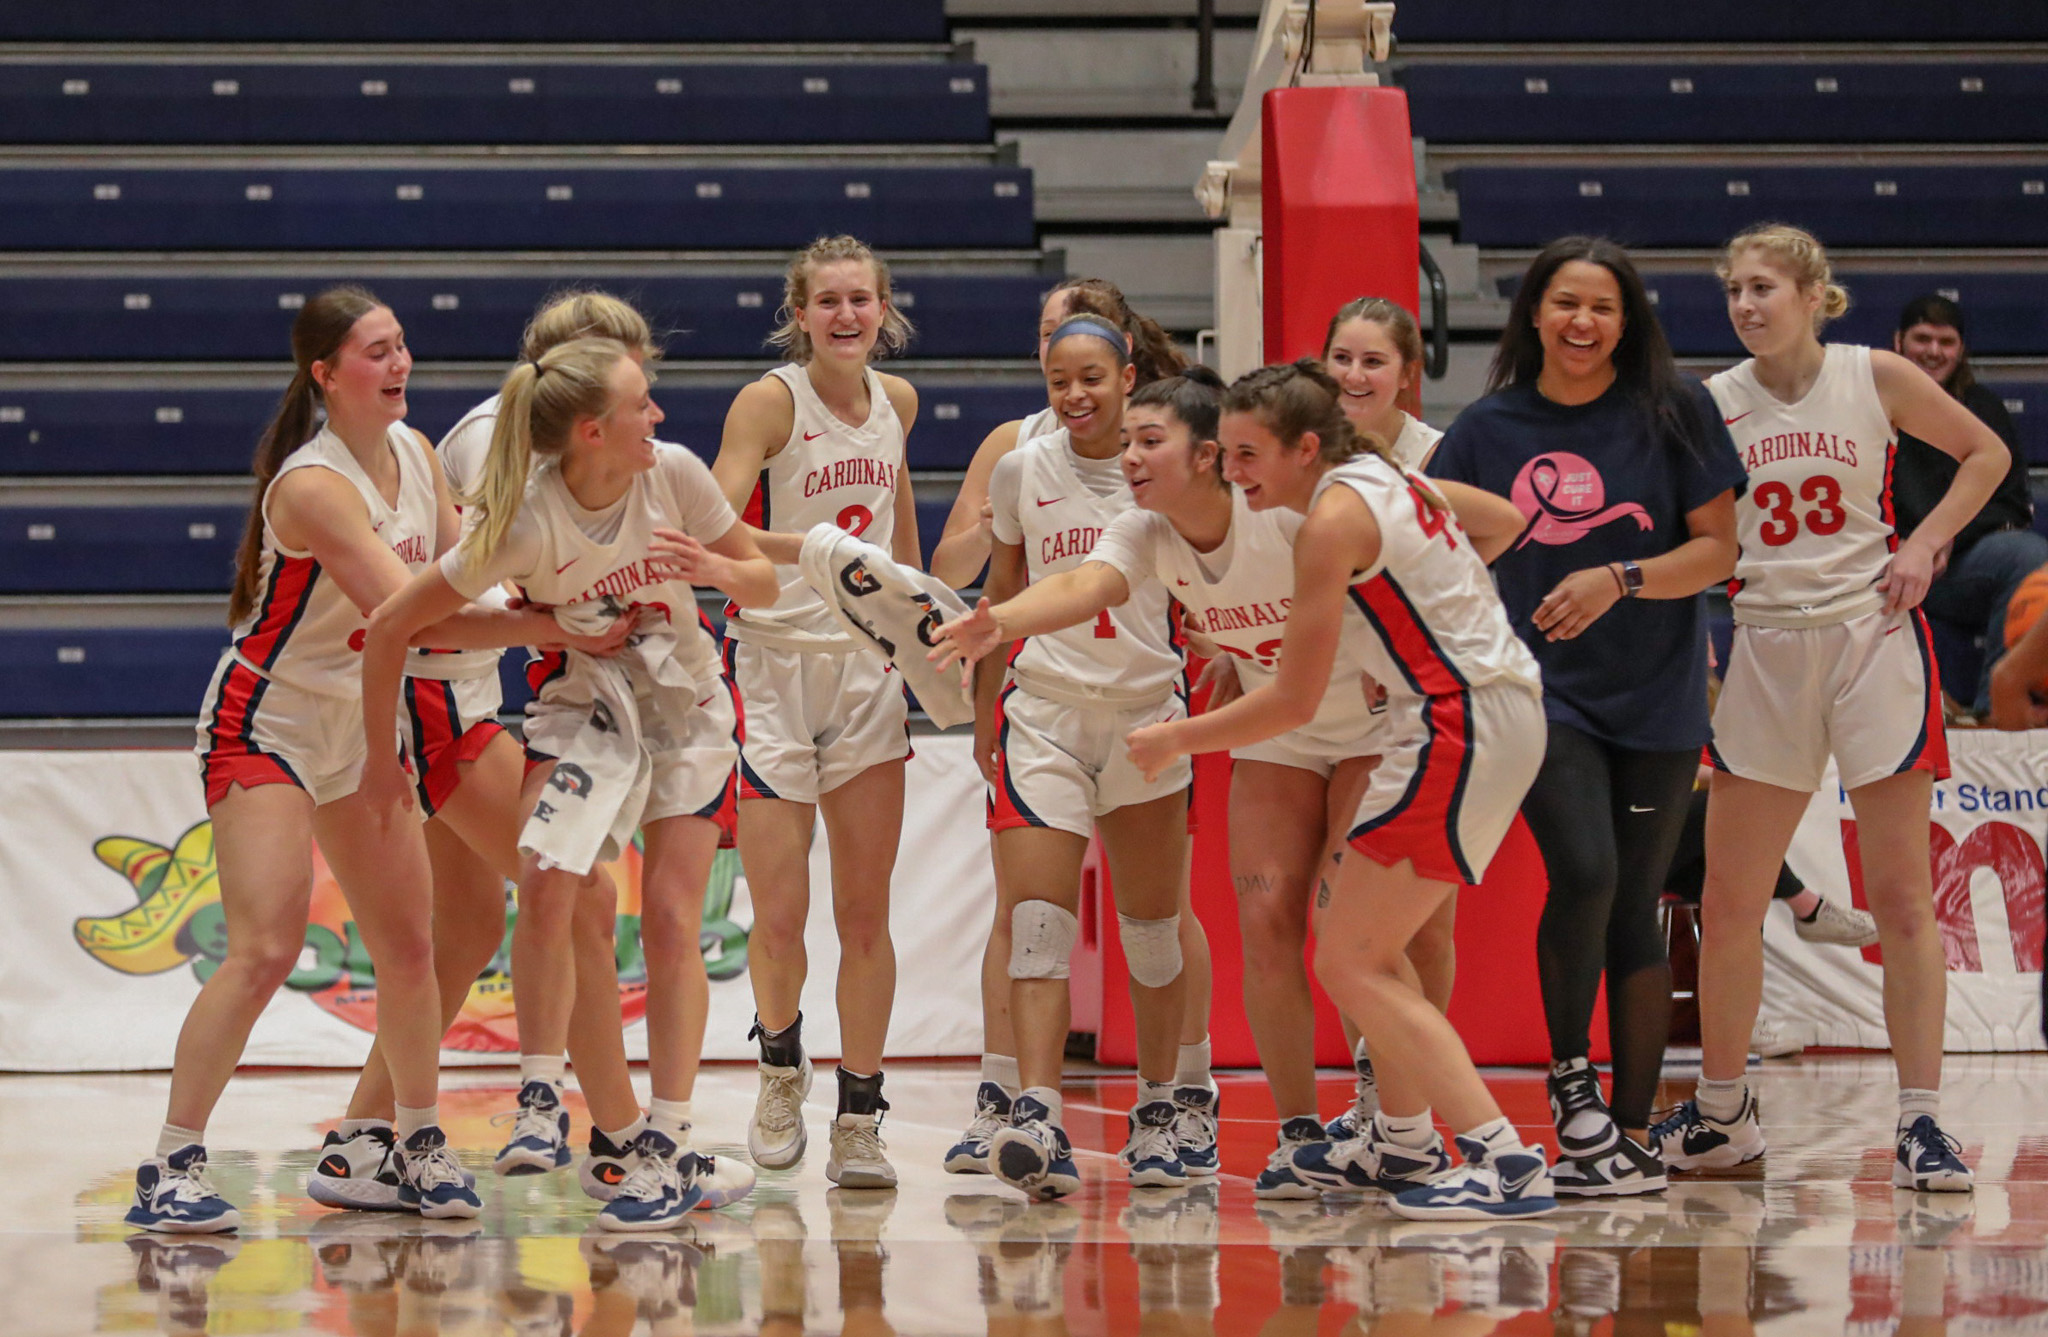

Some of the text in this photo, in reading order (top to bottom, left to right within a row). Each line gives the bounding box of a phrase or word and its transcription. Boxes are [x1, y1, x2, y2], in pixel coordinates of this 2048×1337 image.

[803, 458, 895, 498] CARDINAL
[1562, 483, 1593, 495] CURE
[1563, 472, 1592, 483] JUST
[1406, 473, 1464, 552] 4
[1571, 495, 1584, 507] IT
[1753, 474, 1848, 547] 33
[1201, 598, 1293, 633] RDINALS
